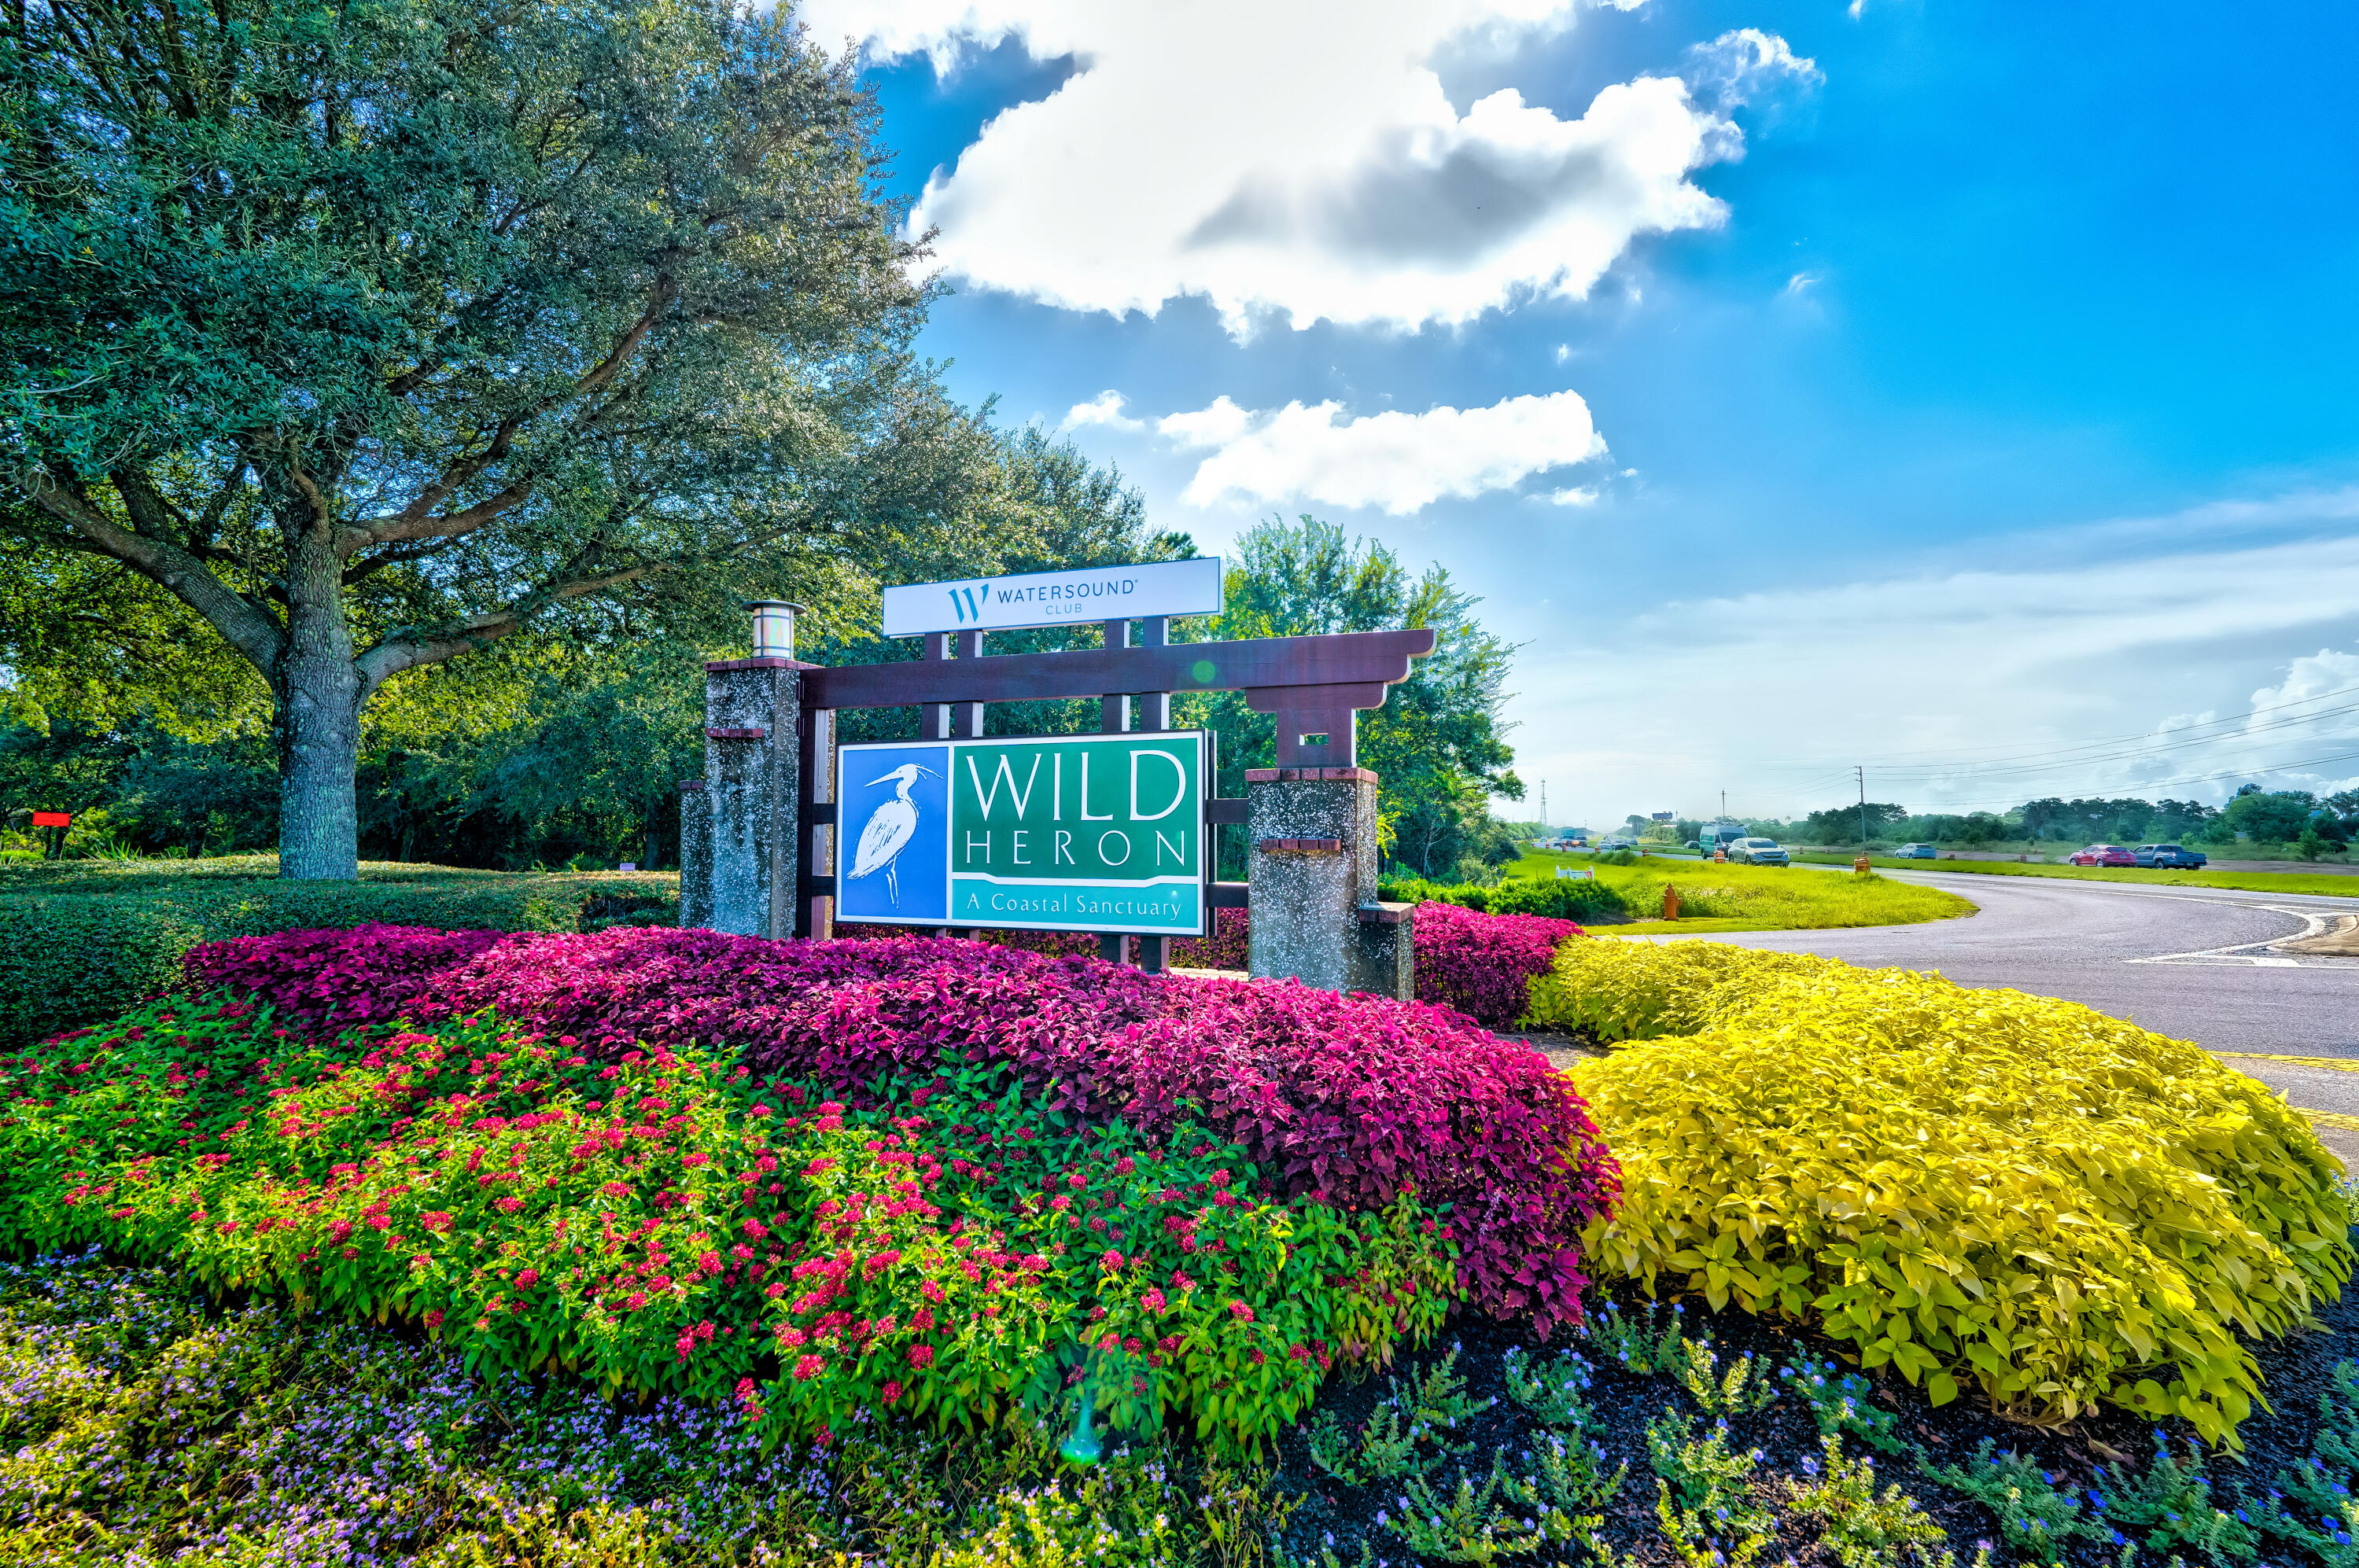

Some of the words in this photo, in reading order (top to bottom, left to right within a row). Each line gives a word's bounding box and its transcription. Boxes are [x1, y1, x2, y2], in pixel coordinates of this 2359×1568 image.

[997, 580, 1134, 604] WATERSOUND
[1045, 603, 1082, 615] CLUB
[966, 749, 1186, 822] WILD
[966, 830, 1185, 867] HERON
[967, 893, 980, 910] A
[991, 893, 1067, 912] Coastal
[1077, 896, 1181, 921] Sanctuary
